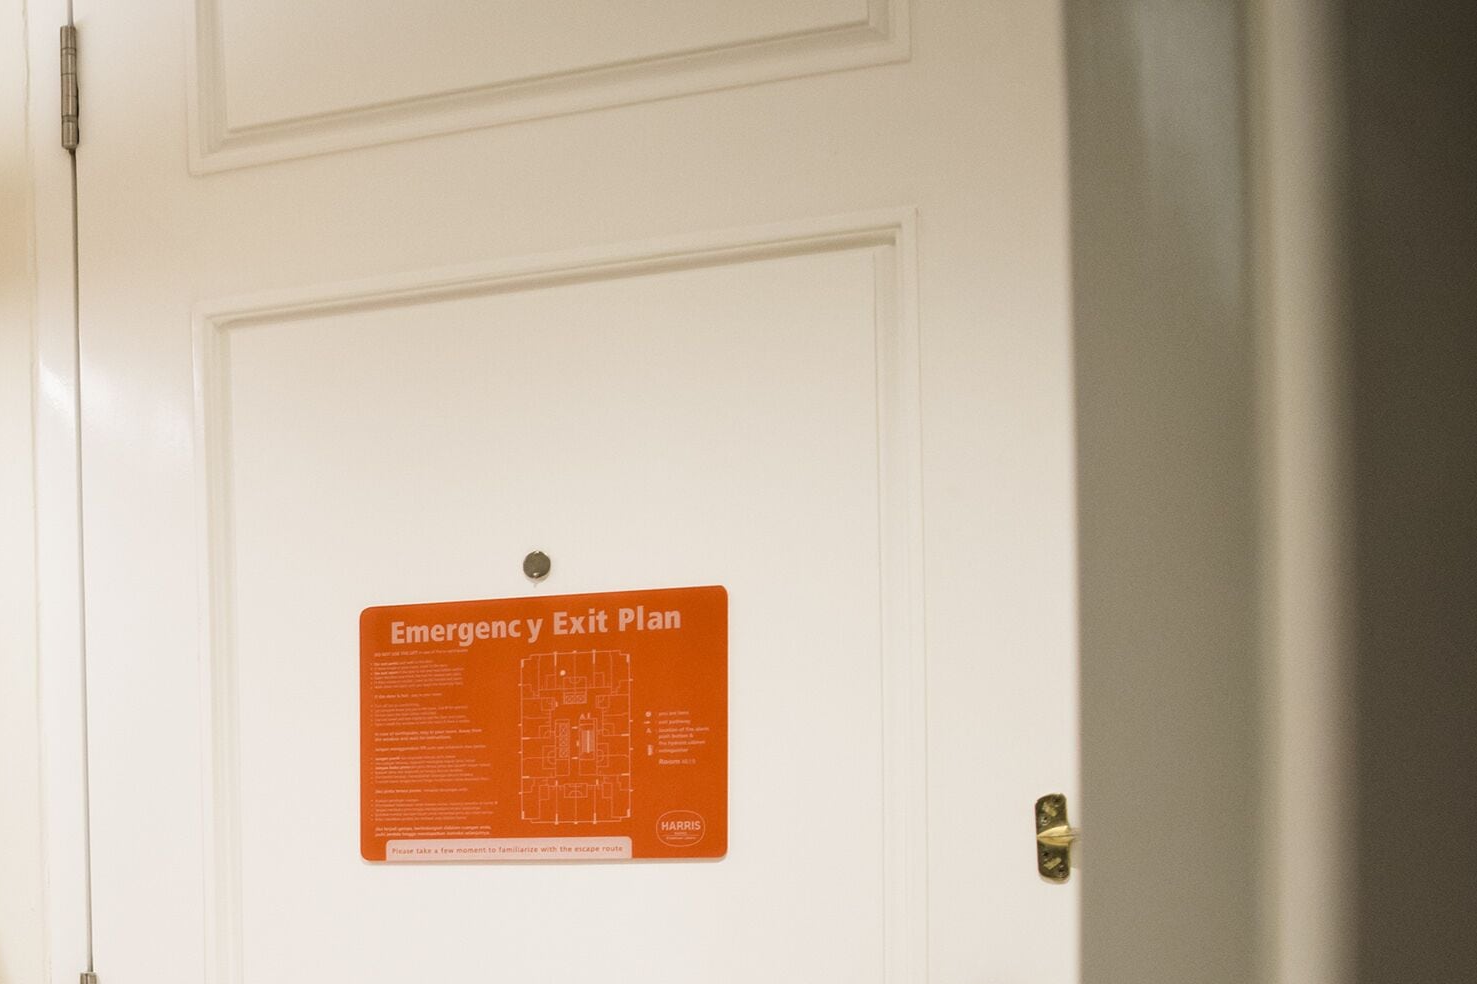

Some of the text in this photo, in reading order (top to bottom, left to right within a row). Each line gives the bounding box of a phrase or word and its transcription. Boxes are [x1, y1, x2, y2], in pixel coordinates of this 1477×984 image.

[553, 607, 608, 635] Exit
[618, 605, 681, 632] Plan
[661, 820, 701, 831] HARRIS
[392, 847, 413, 855] Please
